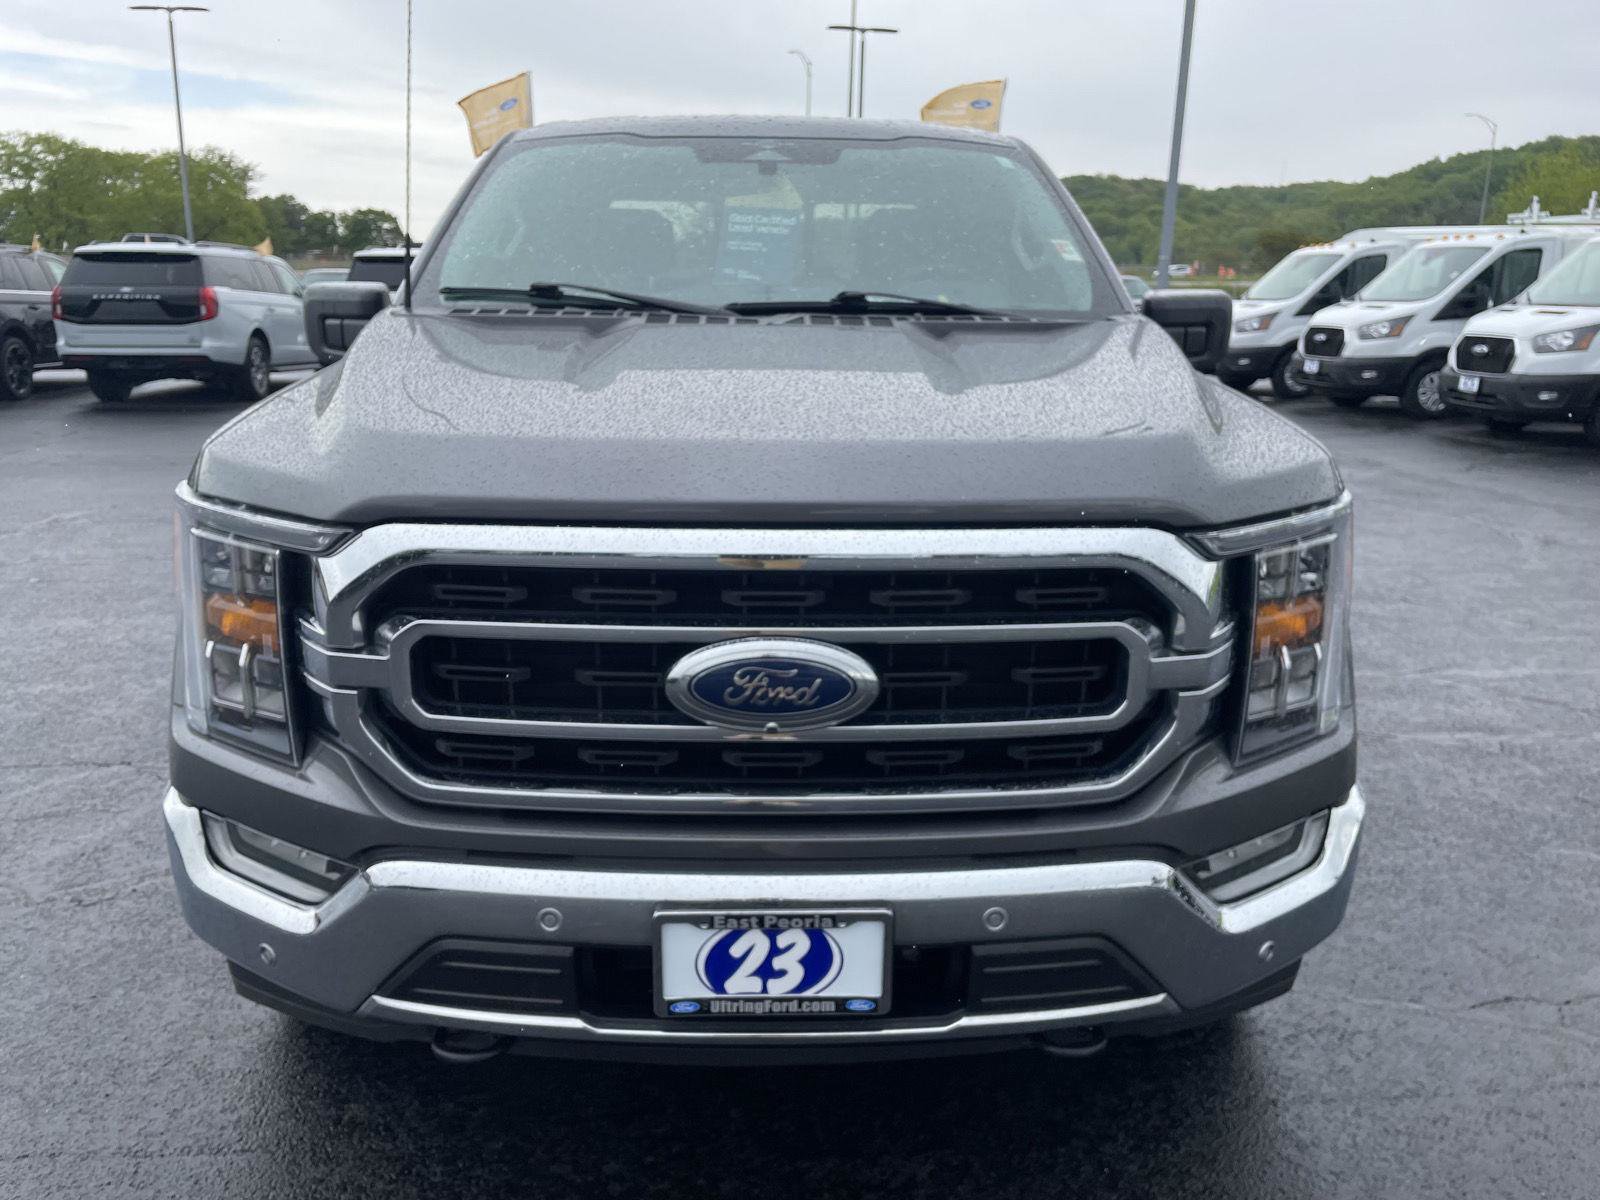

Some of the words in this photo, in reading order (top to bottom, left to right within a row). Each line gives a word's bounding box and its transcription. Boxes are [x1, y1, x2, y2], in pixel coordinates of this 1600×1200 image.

[723, 666, 823, 706] Ford
[713, 915, 760, 929] East
[763, 914, 833, 929] Peoria
[724, 929, 811, 995] 23
